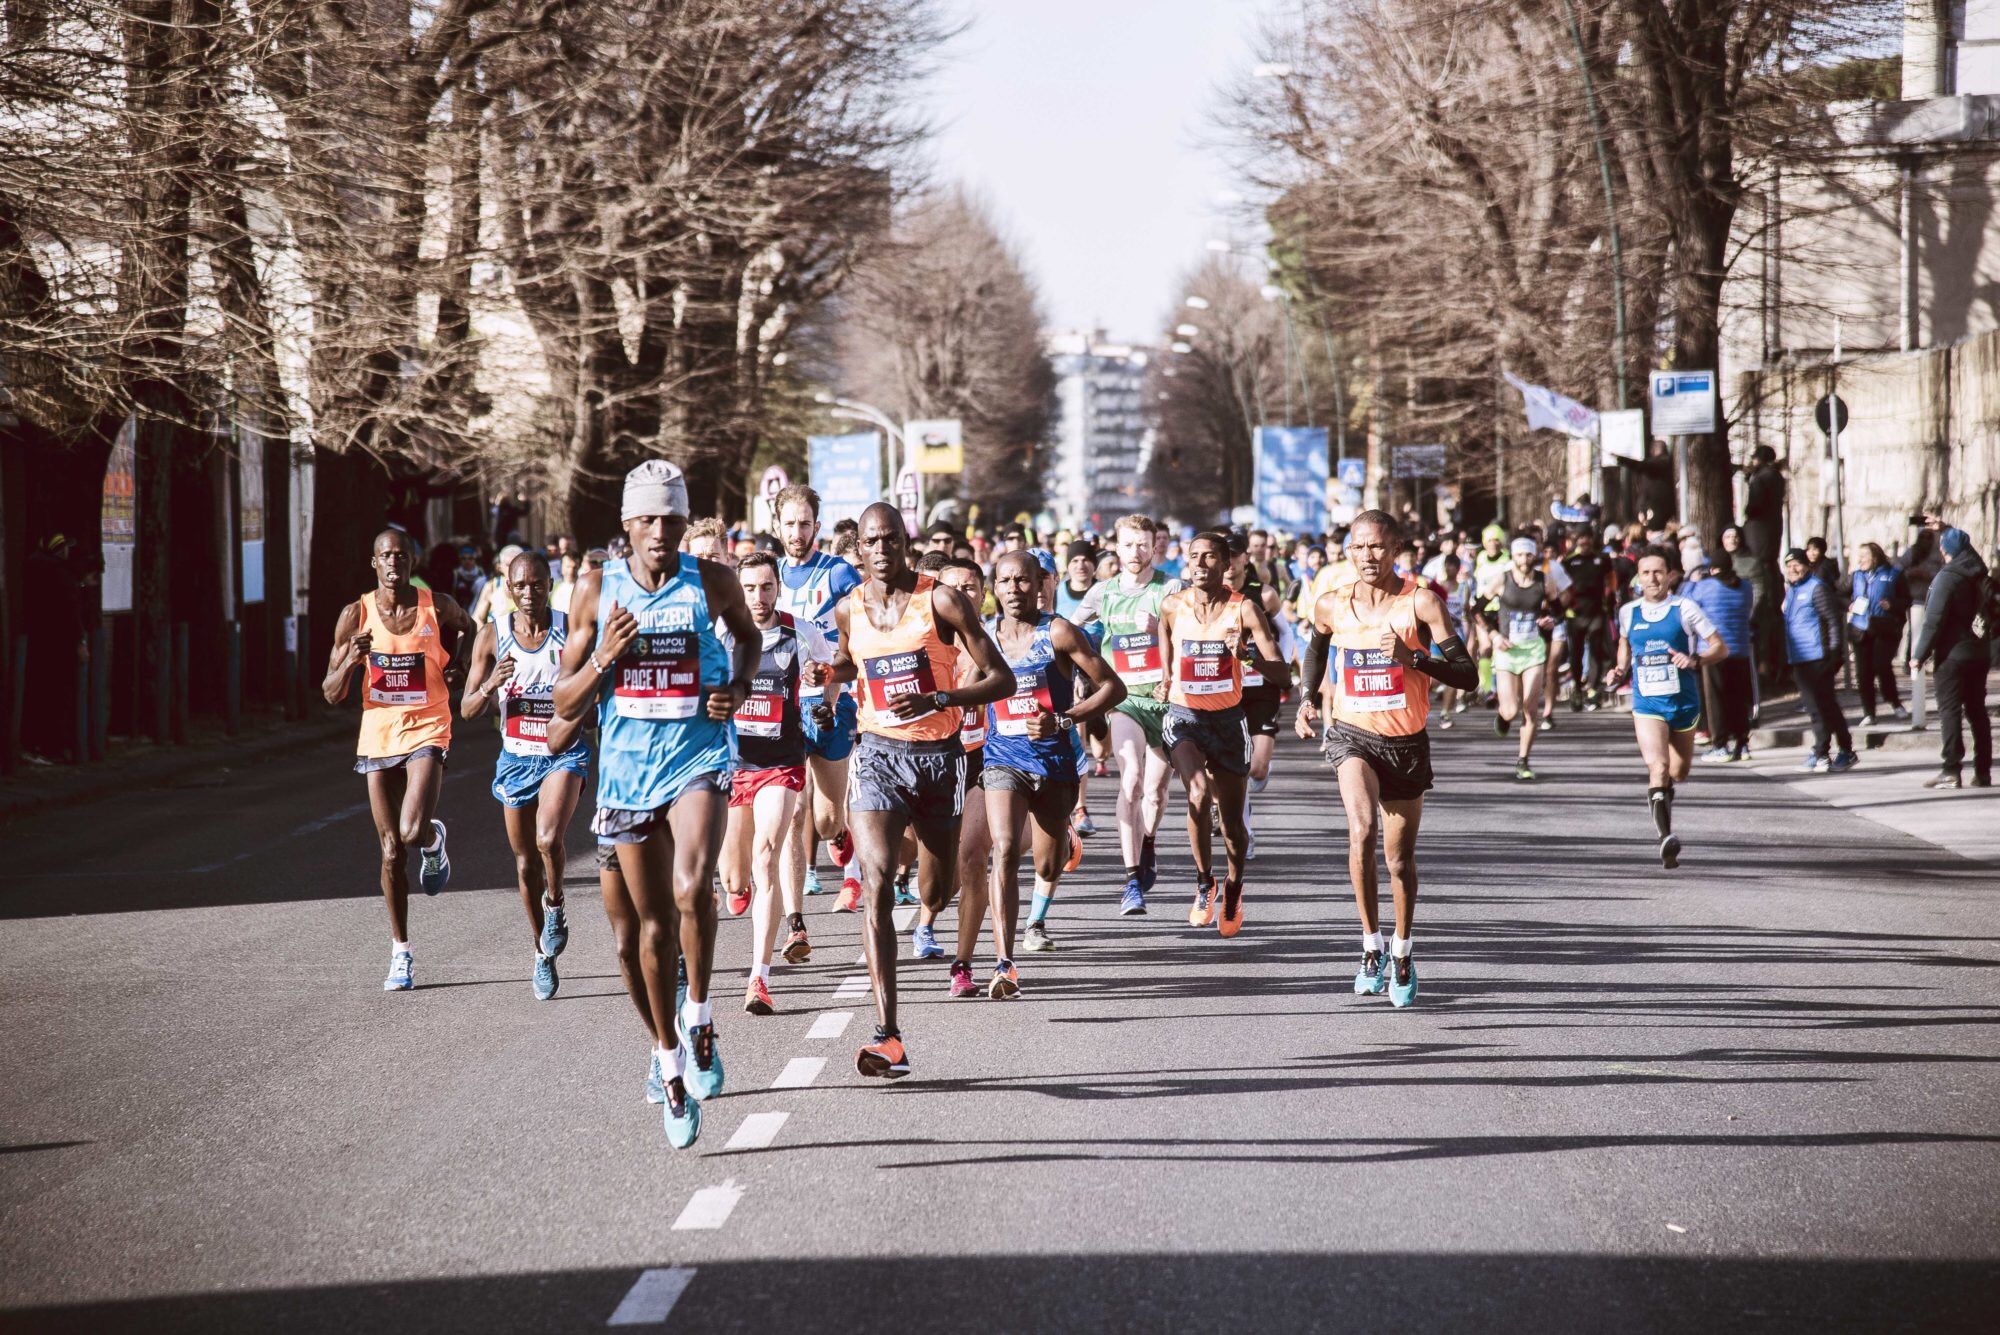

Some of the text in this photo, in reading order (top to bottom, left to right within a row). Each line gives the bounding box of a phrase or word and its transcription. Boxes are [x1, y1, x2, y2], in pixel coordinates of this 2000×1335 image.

[1658, 379, 1673, 396] P
[636, 607, 694, 629] UNCZECH
[652, 637, 686, 647] NAPOLI
[652, 647, 686, 655] RUNNING
[391, 655, 415, 663] NAPOLI
[891, 655, 918, 666] NAPOLI
[1194, 662, 1219, 677] NGUSE
[385, 673, 409, 688] SILAS
[624, 668, 654, 691] PACE
[656, 668, 668, 690] M
[1017, 680, 1038, 689] UNNING
[1354, 674, 1393, 691] BETHWEL
[751, 684, 774, 692] UNNING
[1007, 697, 1038, 715] MOSES
[519, 720, 548, 738] ISHMA
